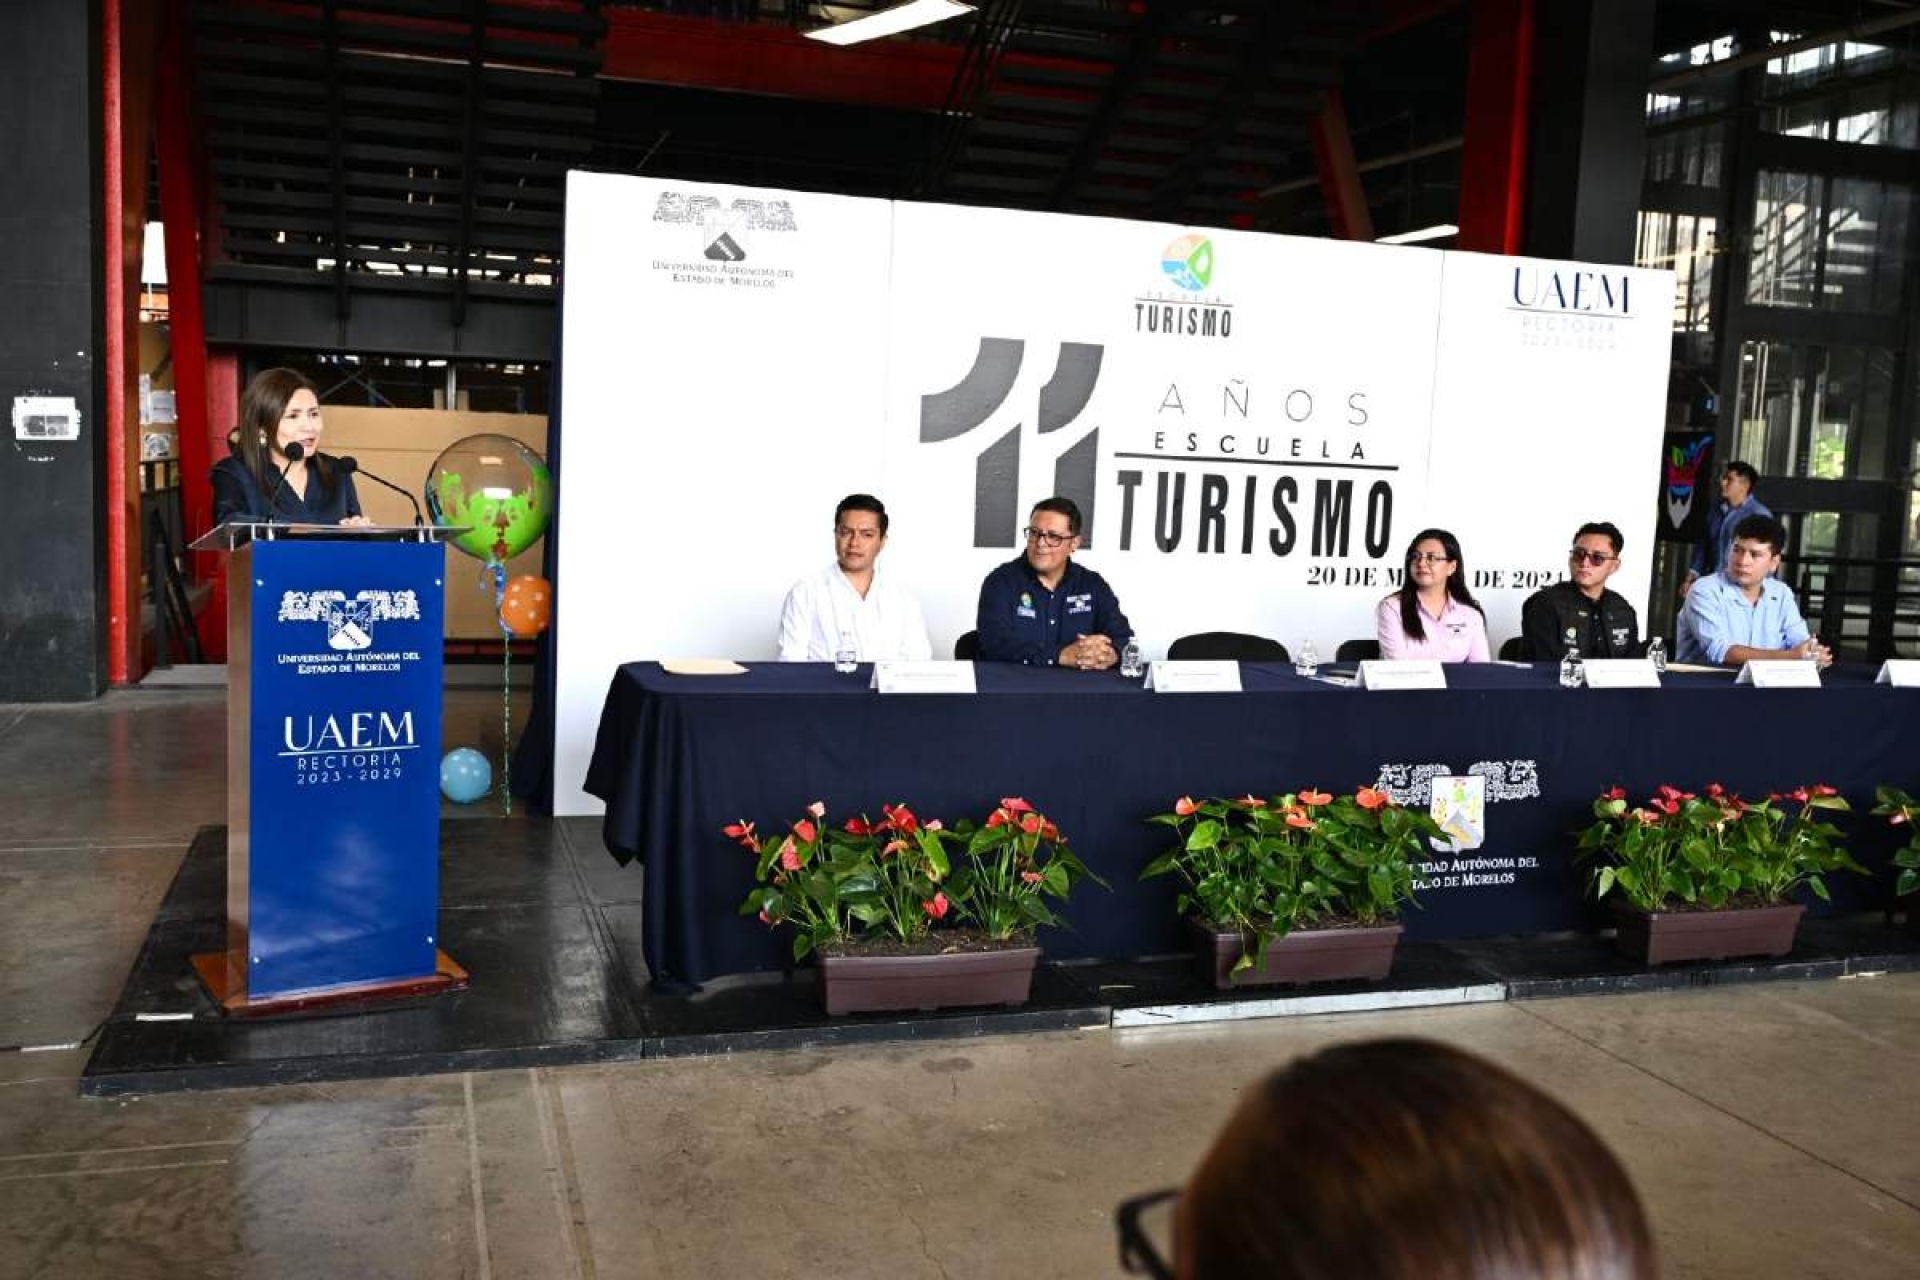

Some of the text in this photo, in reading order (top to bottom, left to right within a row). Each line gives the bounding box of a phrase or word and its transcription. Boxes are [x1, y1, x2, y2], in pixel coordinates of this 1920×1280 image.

[1513, 266, 1629, 314] UAEM
[1134, 303, 1232, 338] TURISMO
[1158, 379, 1369, 426] AÑOS
[1154, 431, 1365, 460] ESCUELA
[1117, 469, 1394, 559] TURISMO
[1306, 566, 1337, 587] 20
[1345, 567, 1377, 587] DE
[1474, 569, 1505, 588] DE
[278, 653, 343, 664] UNIVERSIDAD
[403, 652, 421, 661] DEL
[297, 663, 401, 675] ESTADO DE MORELOS
[284, 711, 414, 751] UAEM
[1451, 856, 1516, 872] AUTÓNOMA
[1518, 857, 1539, 868] DEL
[1444, 876, 1459, 888] DE
[1462, 872, 1516, 887] MORELOS
